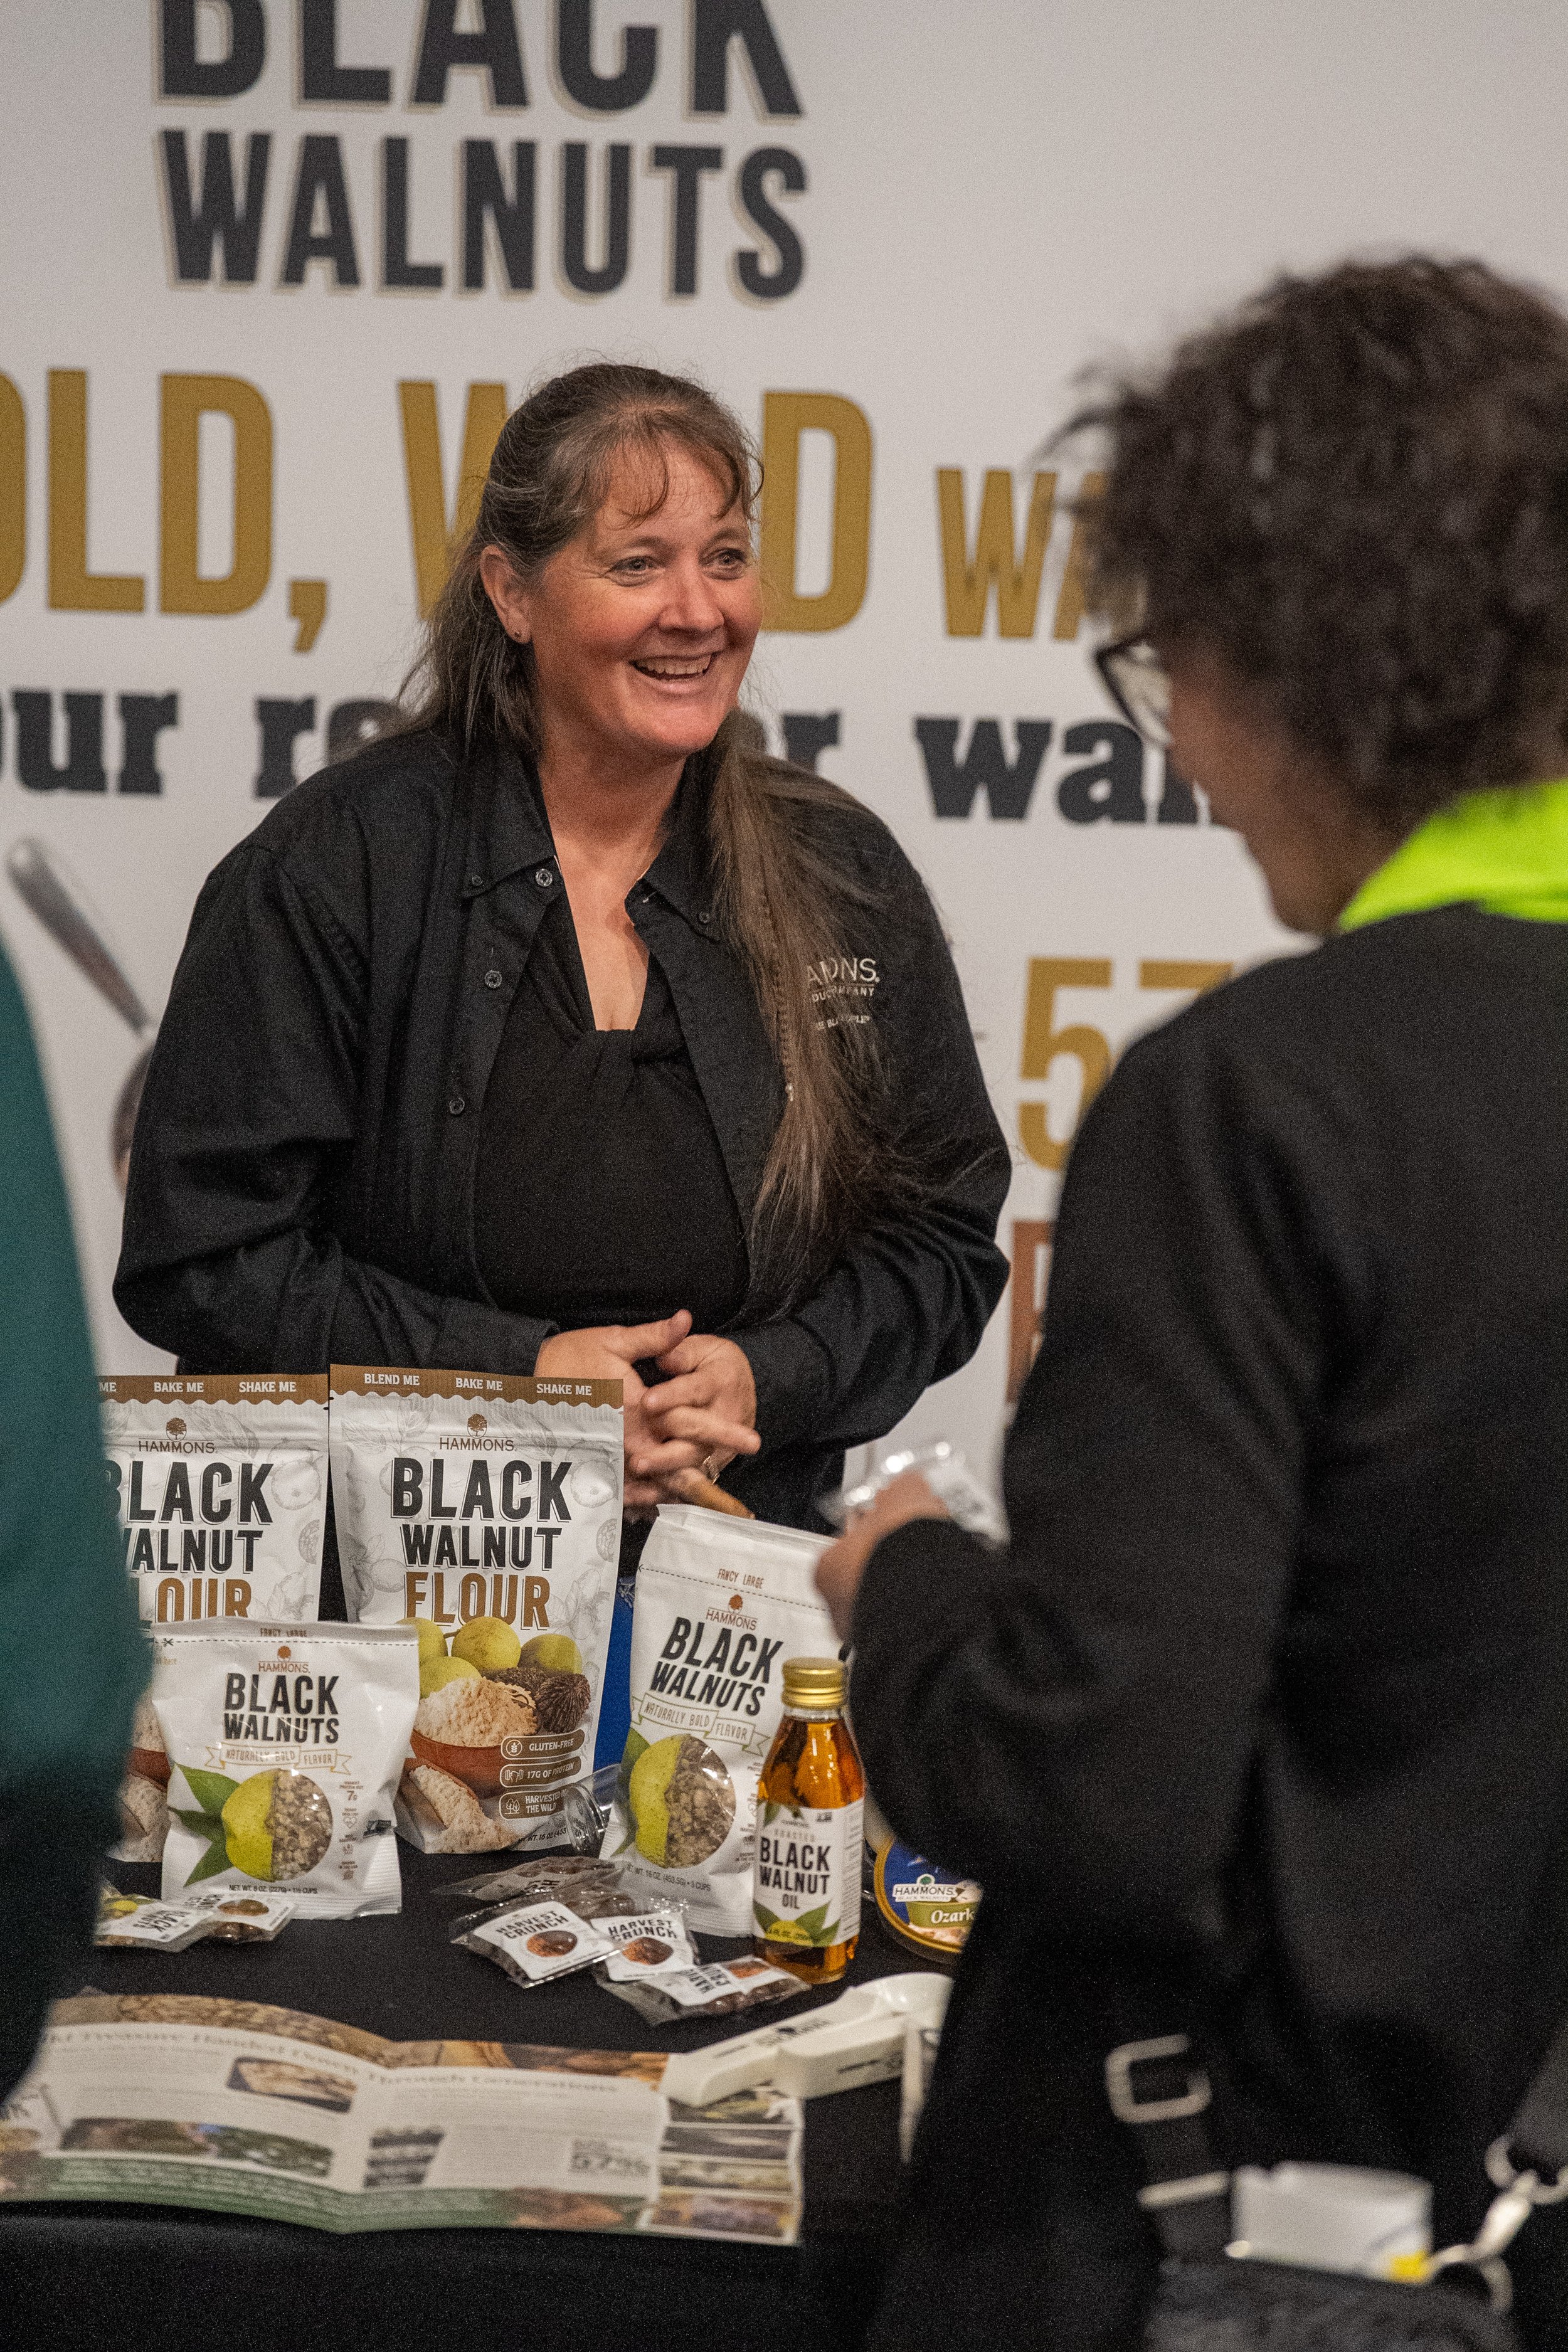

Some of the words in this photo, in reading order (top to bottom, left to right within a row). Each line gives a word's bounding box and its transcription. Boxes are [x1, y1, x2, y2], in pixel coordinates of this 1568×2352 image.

[158, 129, 808, 300] WALNUTS
[154, 1382, 183, 1392] BAKE
[186, 1382, 204, 1393] ME
[238, 1382, 277, 1392] SHAKE
[278, 1381, 297, 1392] ME
[364, 1374, 400, 1385] BLEND
[403, 1374, 420, 1385] ME
[455, 1378, 484, 1389] BAKE
[485, 1379, 503, 1391] ME
[536, 1384, 572, 1396] SHAKE
[575, 1385, 592, 1396] ME
[138, 1440, 215, 1454] HAMMONS
[440, 1438, 515, 1452] HAMMONS
[390, 1457, 573, 1522] BLACK
[124, 1527, 263, 1573] ALNUT
[400, 1524, 563, 1571] WALNUT
[717, 1568, 739, 1582] FANCY
[743, 1575, 765, 1590] LARGE
[154, 1577, 252, 1623] OUR
[404, 1571, 551, 1631] FLOUR
[705, 1608, 758, 1631] HAMMONS
[660, 1616, 783, 1685] BLACK
[258, 1663, 309, 1673] HAMMONS
[223, 1672, 339, 1715] BLACK
[649, 1660, 766, 1717] WALNUTS
[223, 1712, 339, 1744] WALNUTS
[644, 1703, 686, 1725] NATURALLY
[689, 1712, 710, 1728] BOLD
[716, 1722, 748, 1740] FLAVOR
[529, 1737, 575, 1752] GLUTEN-FREE
[304, 1754, 332, 1765] FLAVOR
[527, 1770, 541, 1779] 17G
[543, 1769, 552, 1779] OF
[552, 1761, 575, 1776] PROTEIN
[525, 1791, 560, 1804] HARVESTED
[526, 1805, 540, 1814] THE
[541, 1803, 557, 1812] WILD
[760, 1836, 831, 1872] BLACK
[695, 1882, 711, 1892] CUPS
[759, 1865, 830, 1895] WALNUT
[894, 1886, 954, 1895] HAMMONS
[781, 1894, 800, 1910] OIL
[495, 1910, 558, 1934] HARVEST
[504, 1915, 569, 1939] CRUNCH
[607, 1919, 673, 1936] HARVEST
[612, 1926, 677, 1941] CRUNCH
